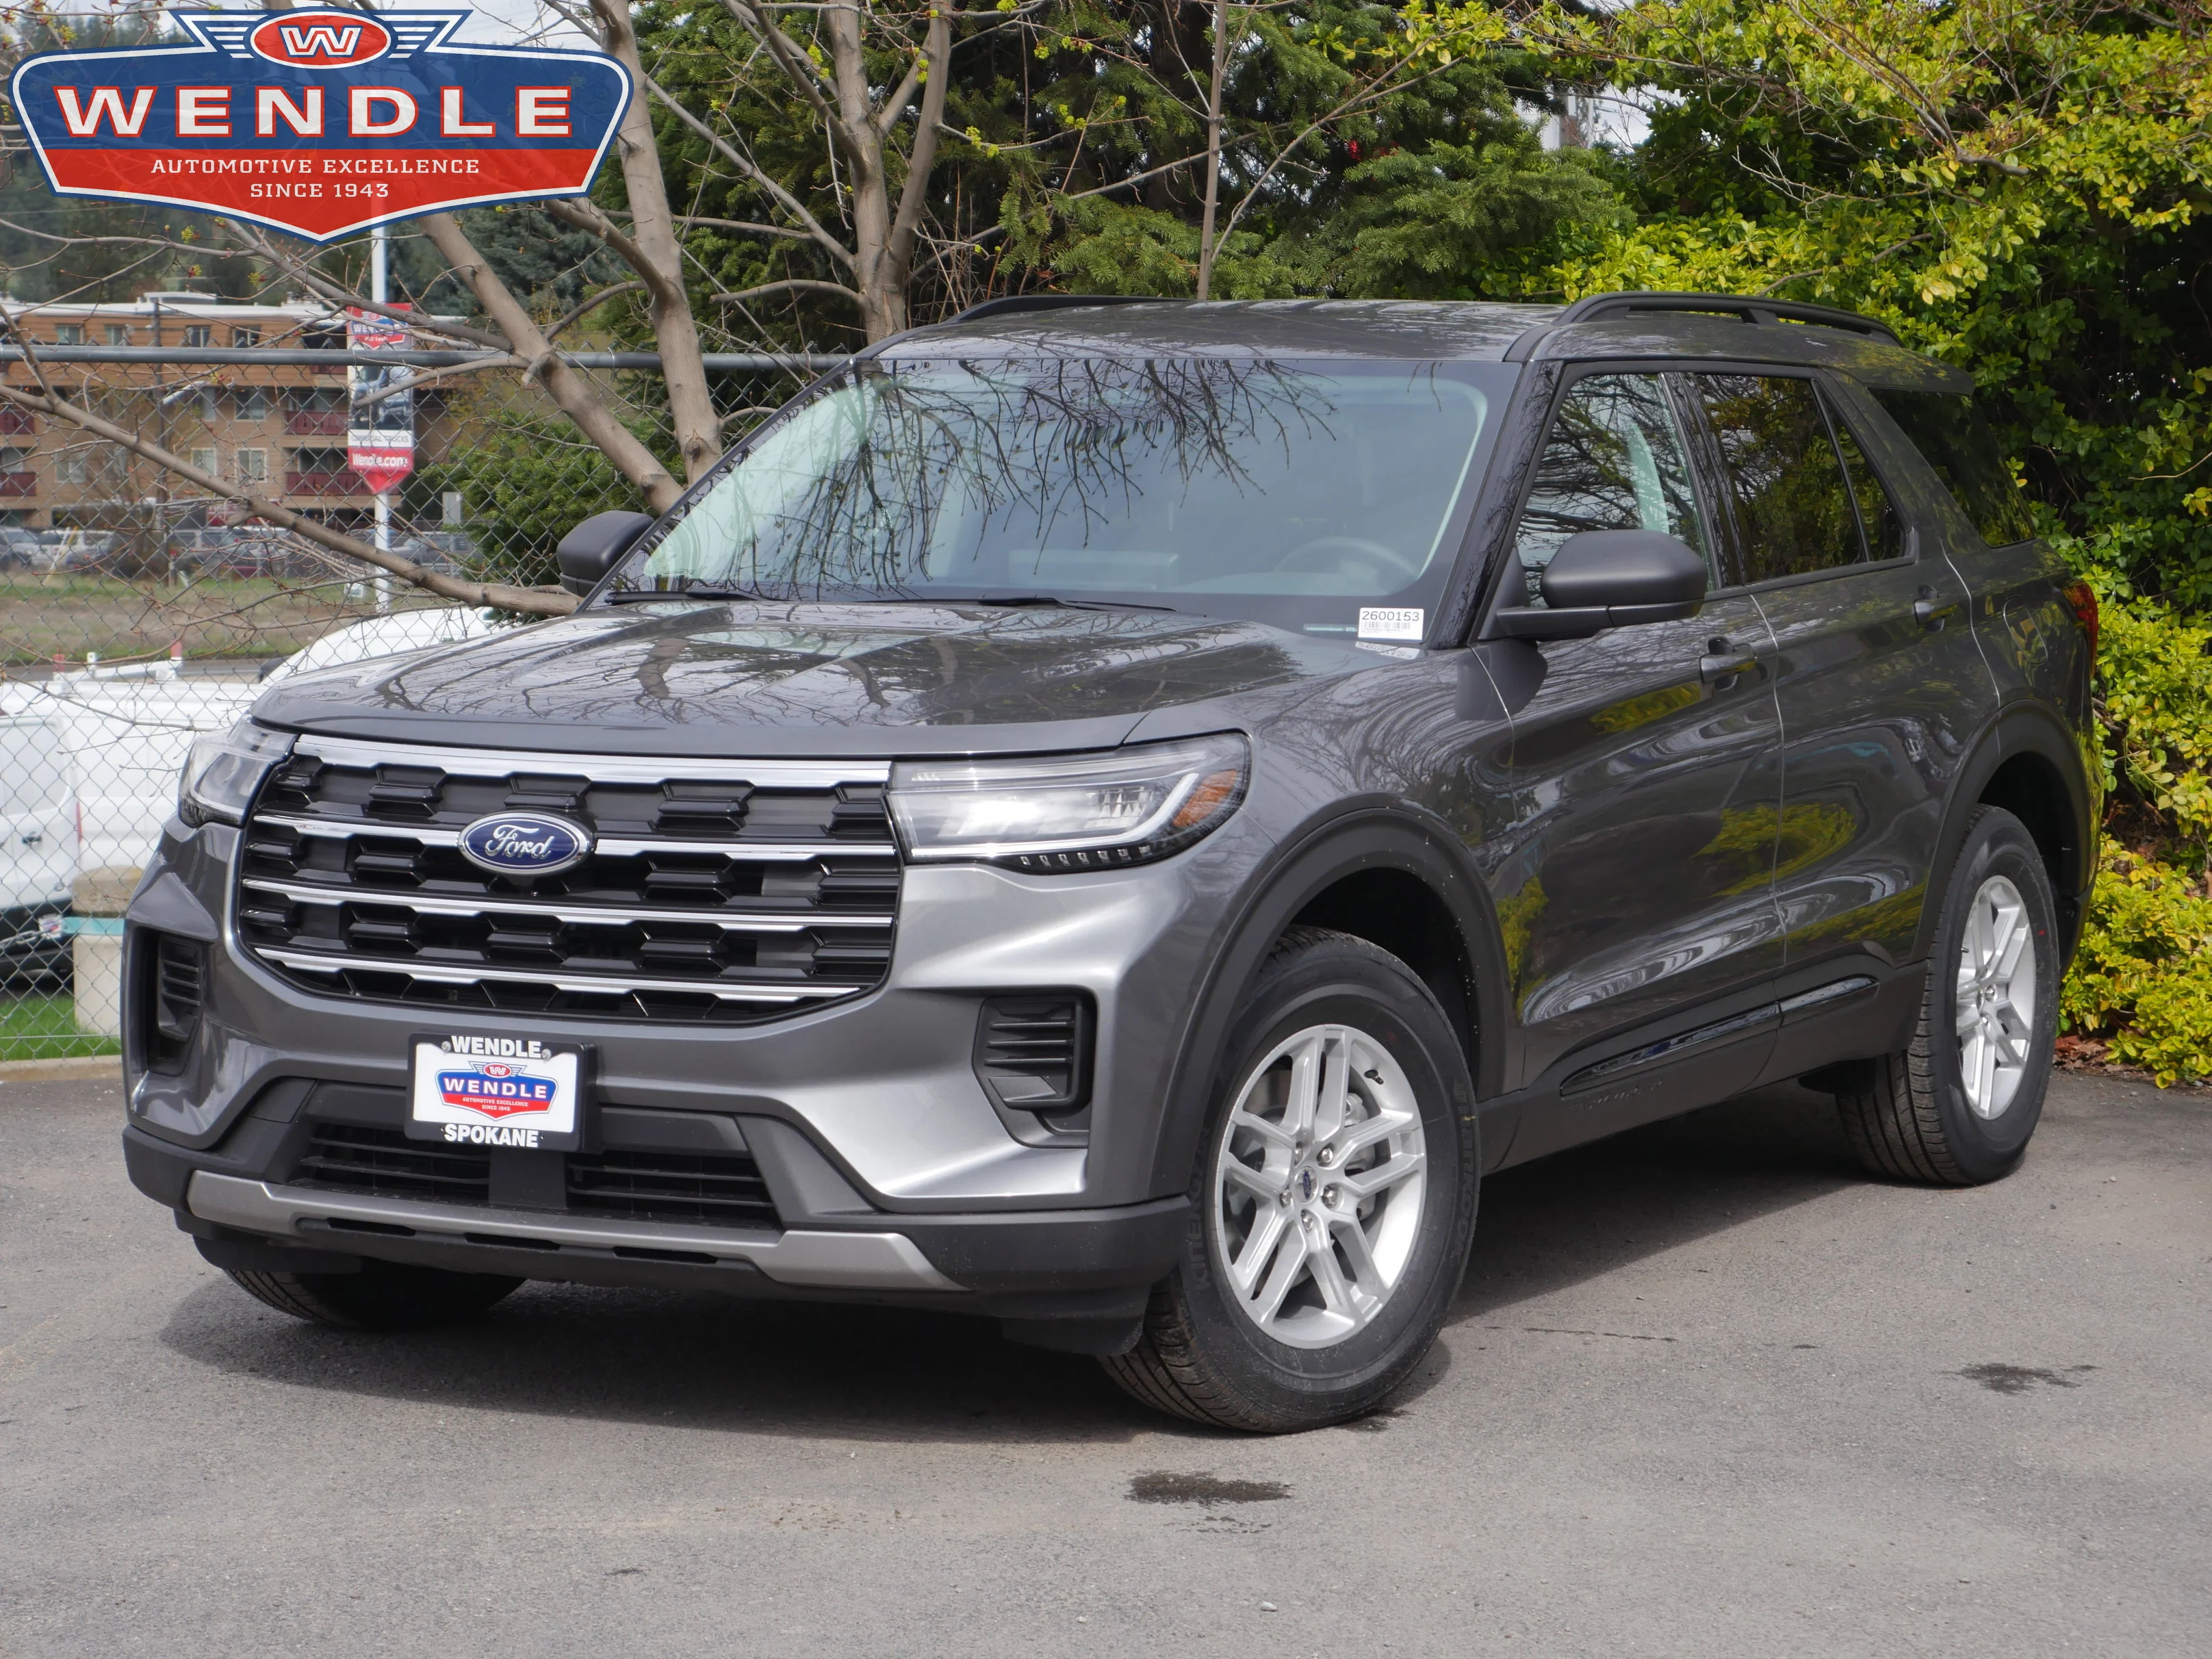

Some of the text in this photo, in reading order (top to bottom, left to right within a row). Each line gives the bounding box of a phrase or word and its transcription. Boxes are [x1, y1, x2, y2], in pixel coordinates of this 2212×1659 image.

[1362, 610, 1419, 621] 2600153
[485, 824, 554, 859] Ford
[451, 1036, 541, 1058] WENDLE
[443, 1077, 547, 1099] WENDLE
[444, 1124, 539, 1148] SPOKANE
